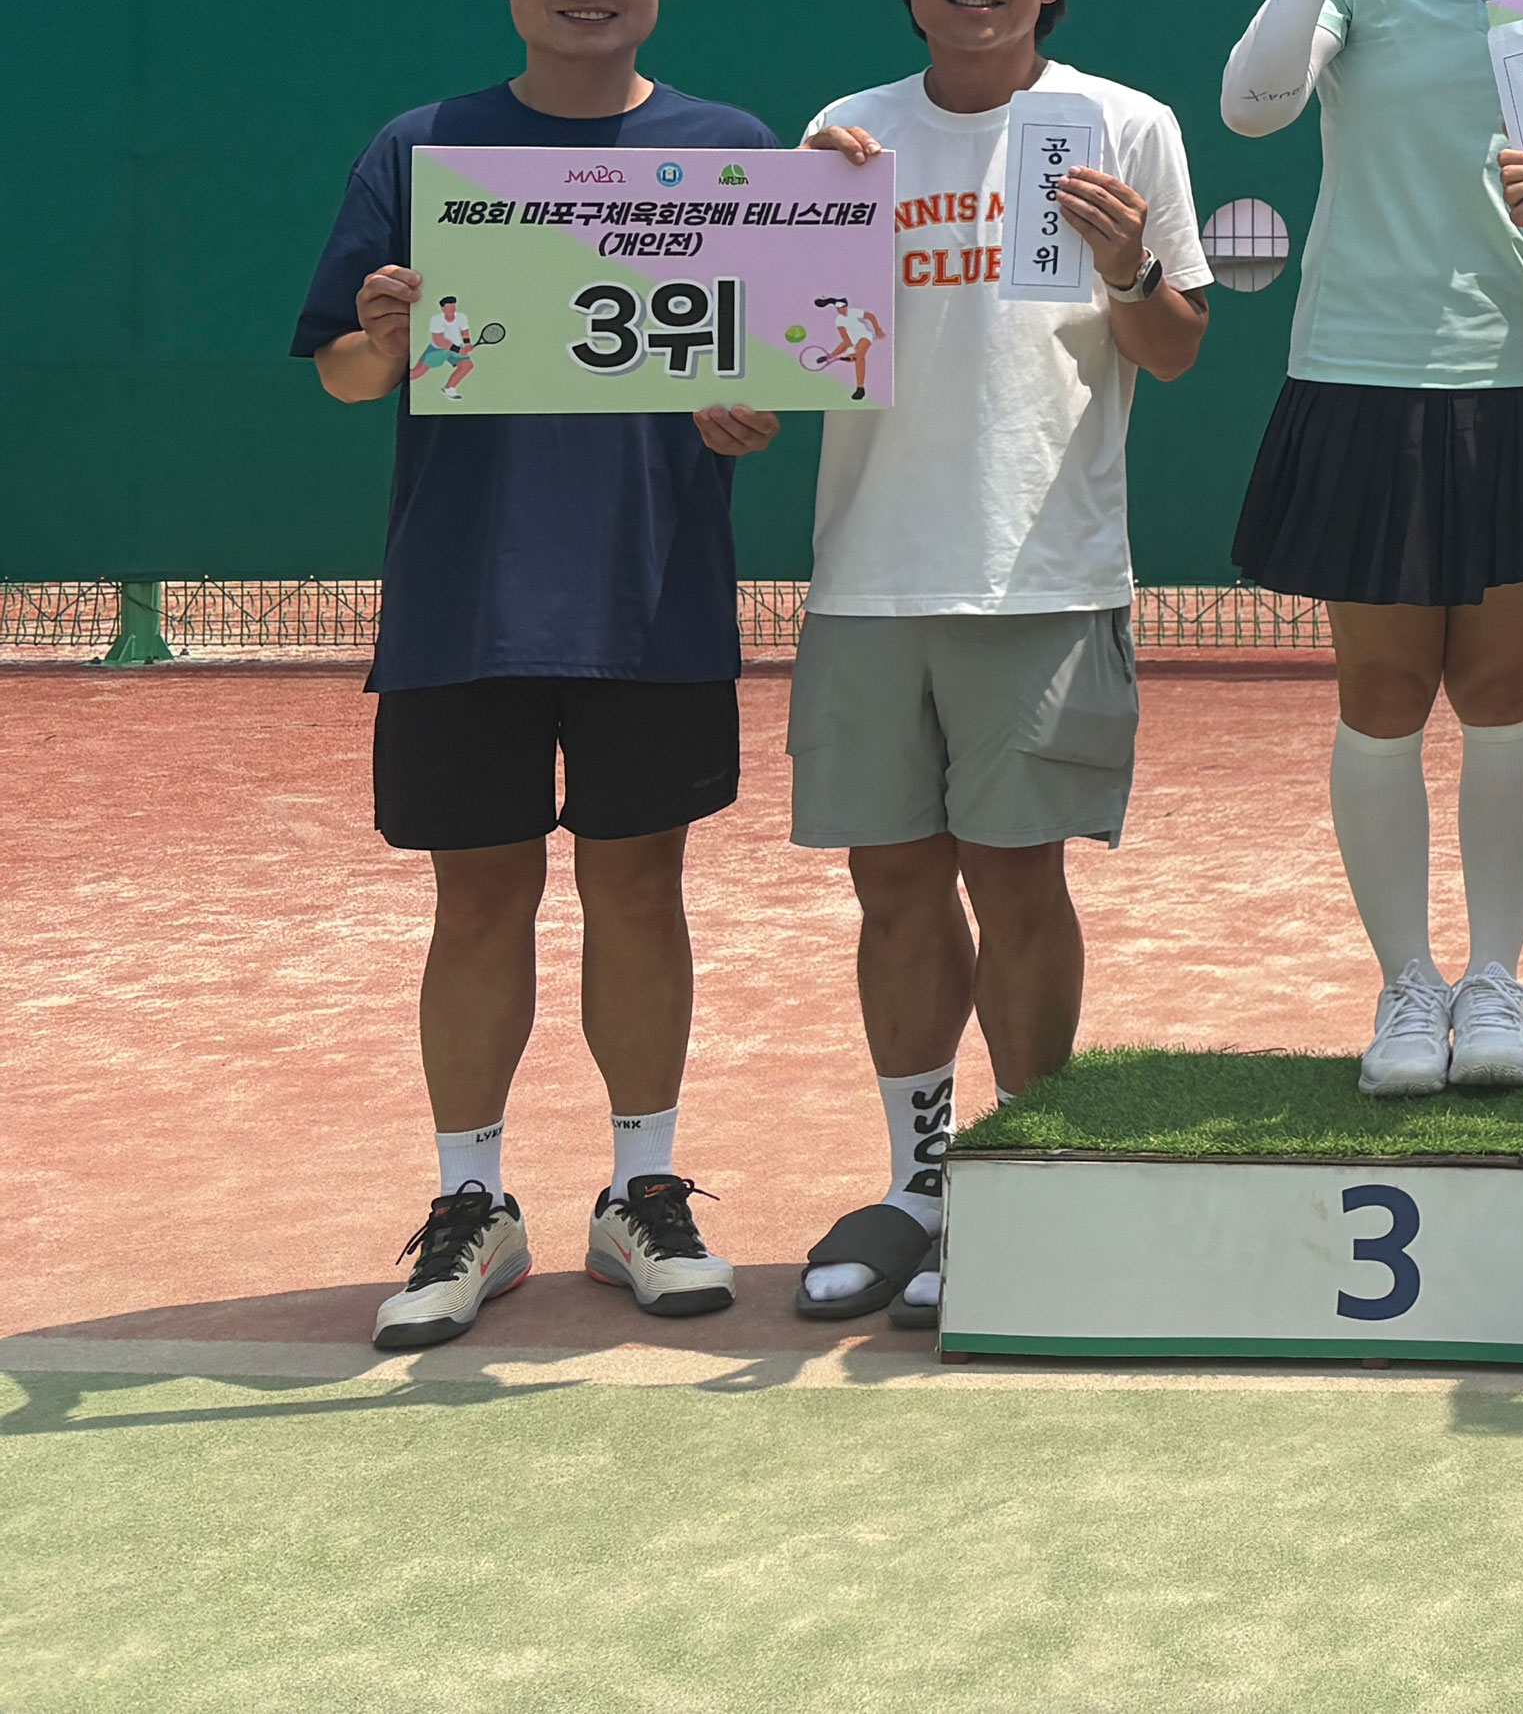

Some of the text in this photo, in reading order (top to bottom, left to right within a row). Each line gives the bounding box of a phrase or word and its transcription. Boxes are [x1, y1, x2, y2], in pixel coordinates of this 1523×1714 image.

[437, 200, 877, 227] 제8회 마포구체육회장배 테니스대회
[597, 231, 704, 258] (개인전)
[569, 276, 742, 376] 3위
[1337, 1184, 1421, 1322] 3
